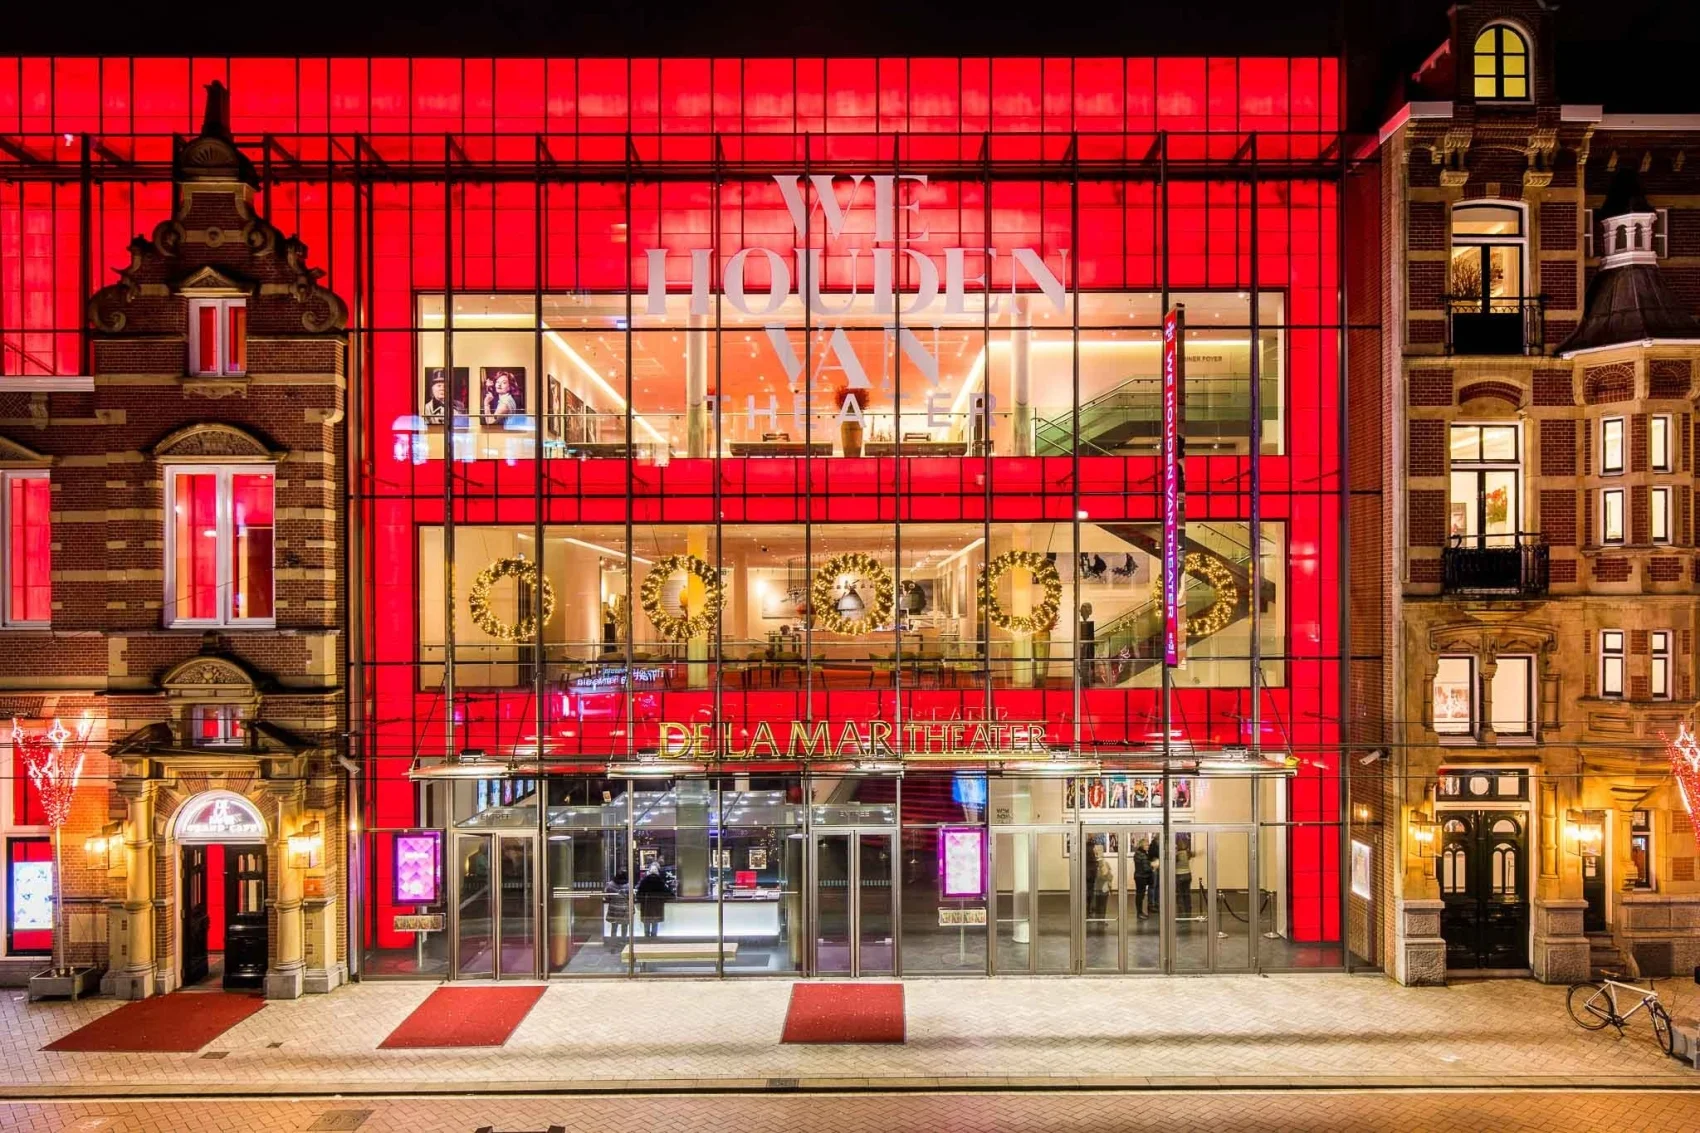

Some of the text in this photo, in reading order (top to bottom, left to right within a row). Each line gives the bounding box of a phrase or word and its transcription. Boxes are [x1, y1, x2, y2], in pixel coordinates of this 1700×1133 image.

[772, 175, 929, 242] WE
[644, 247, 1069, 315] HOUDEN
[764, 322, 940, 389] VAN
[1166, 350, 1174, 387] WE
[703, 391, 996, 430] THEATER
[1166, 392, 1174, 479] HOUDEN
[1166, 484, 1175, 526] VAN
[1166, 530, 1175, 619] THEATER
[903, 723, 1047, 755] THEATER
